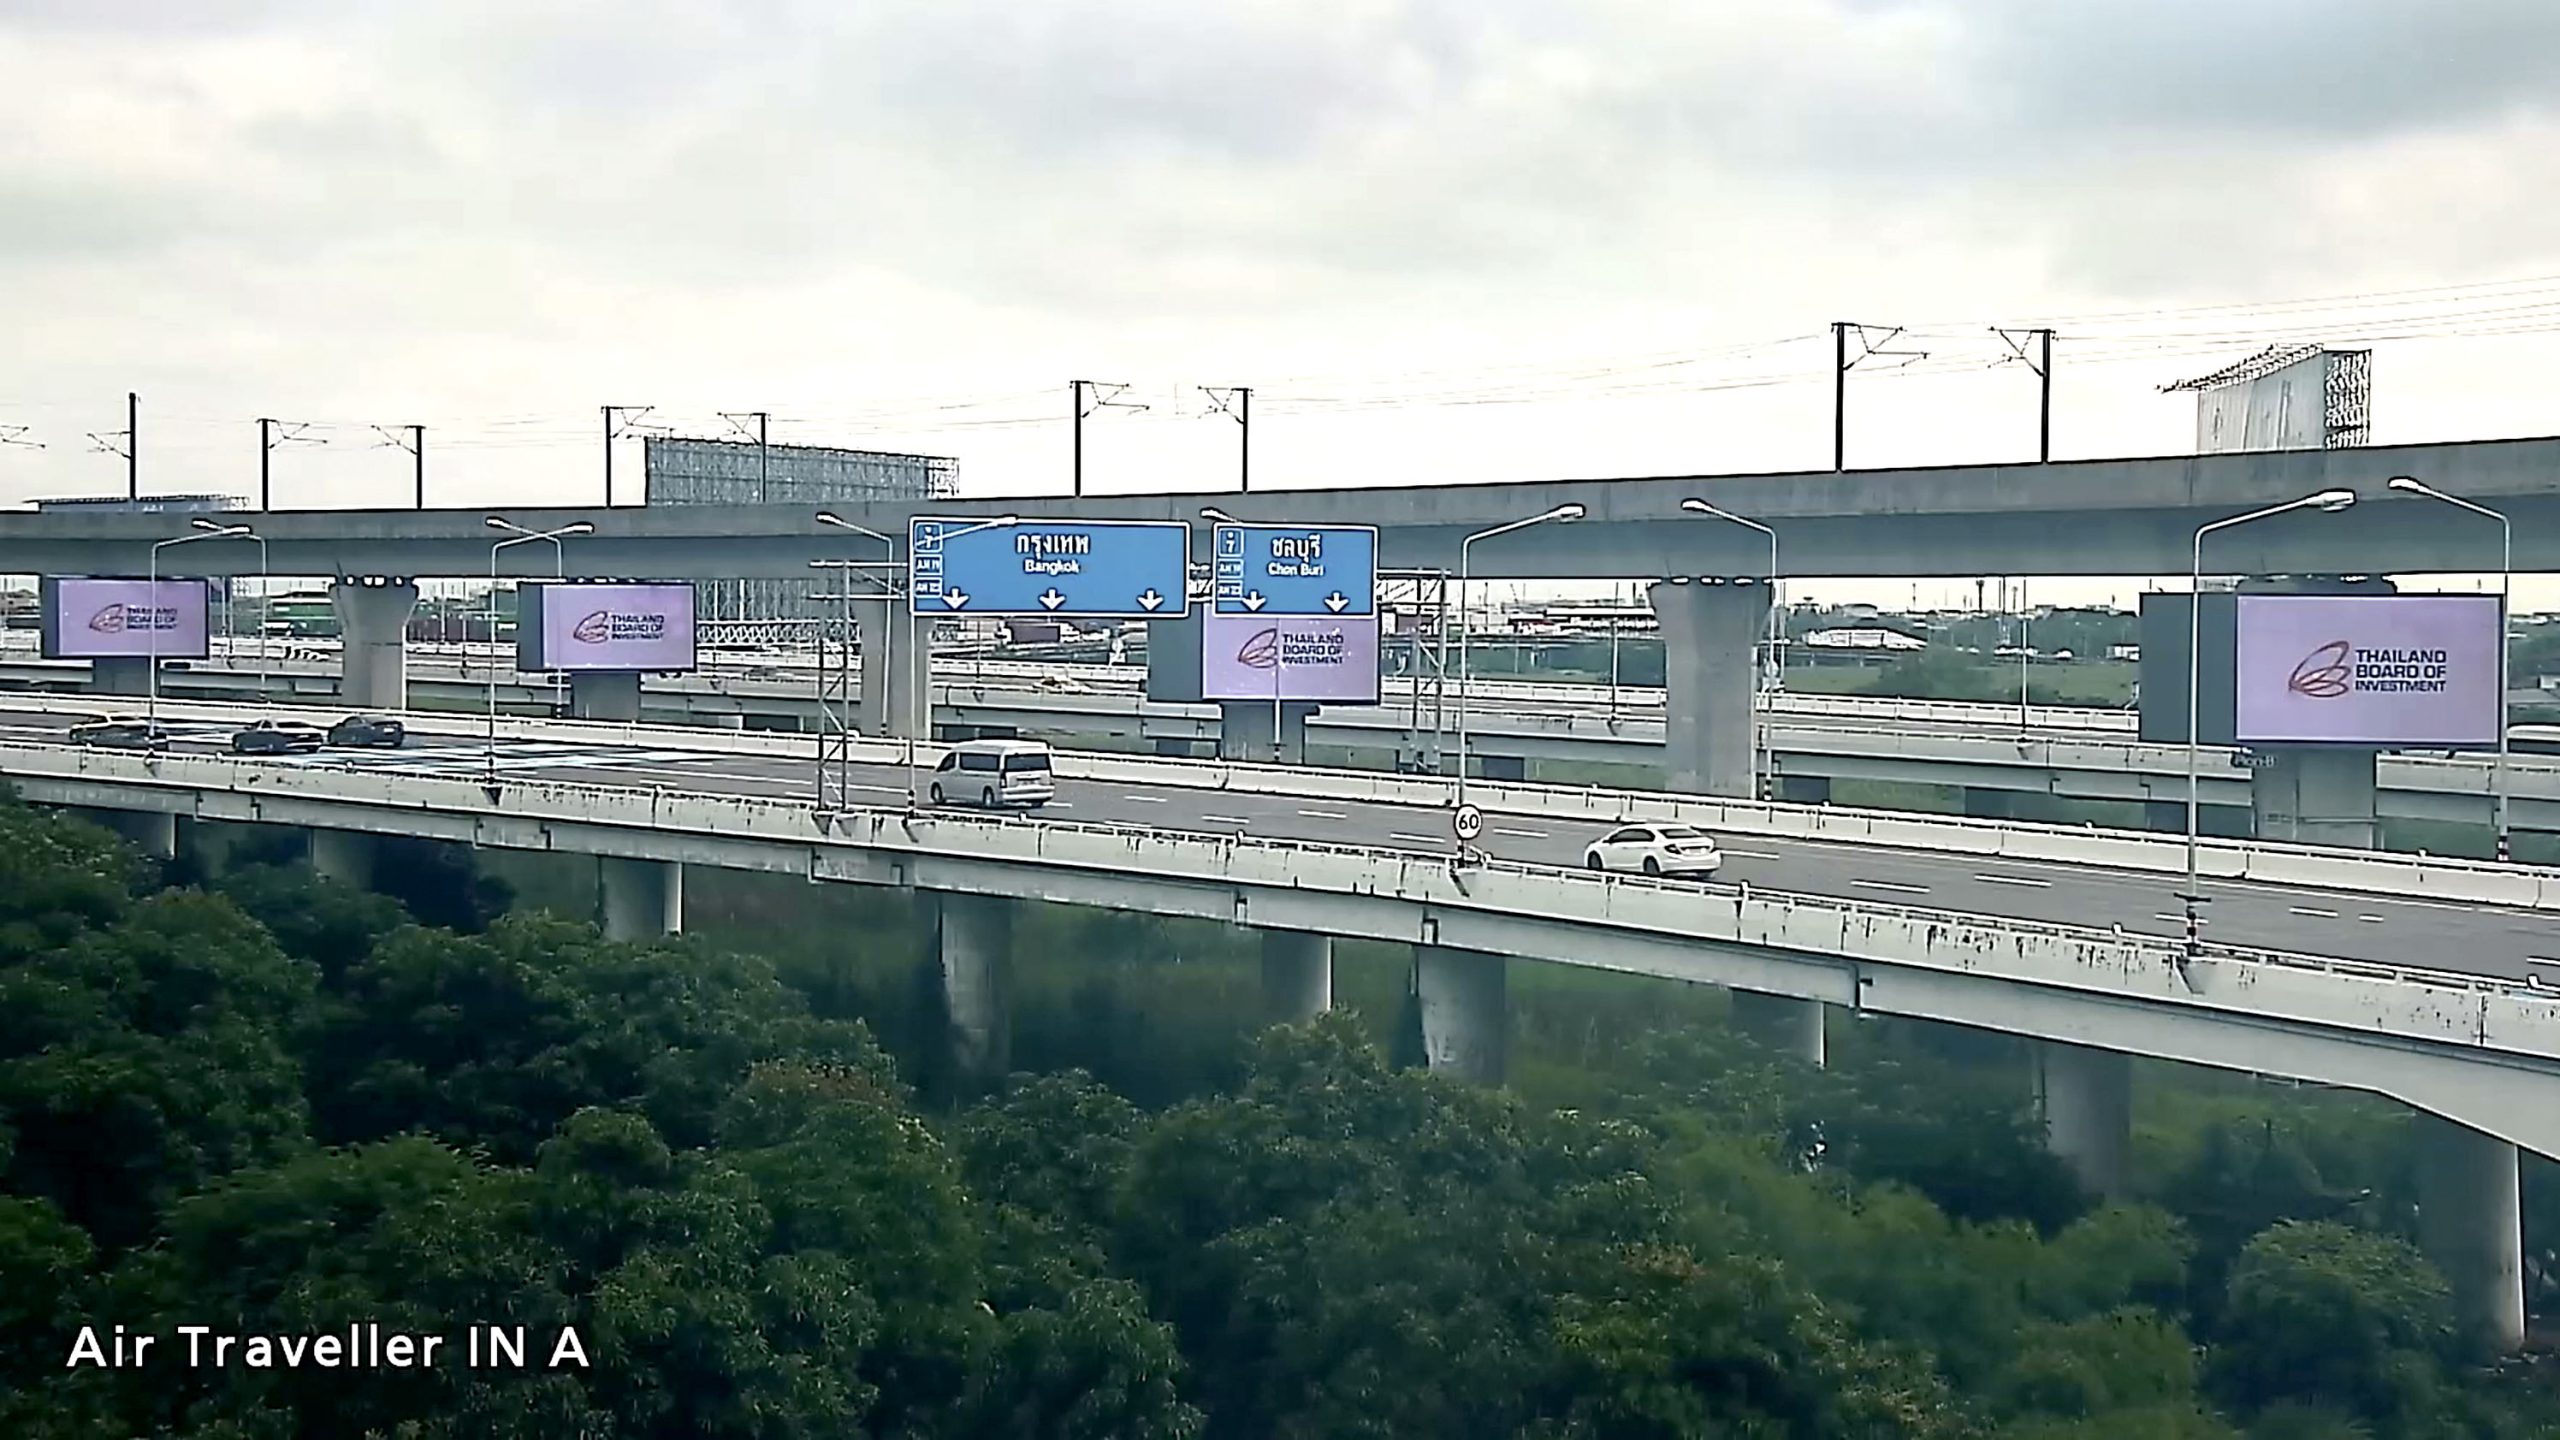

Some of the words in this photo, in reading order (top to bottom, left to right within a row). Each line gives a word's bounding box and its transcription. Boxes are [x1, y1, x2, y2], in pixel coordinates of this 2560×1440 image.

[1016, 534, 1090, 559] กรุงเทพ
[1225, 540, 1235, 553] 7
[1271, 534, 1322, 562] ชลบุรี
[1024, 559, 1080, 575] Bangkok
[1267, 562, 1298, 576] Chon
[1300, 563, 1324, 576] Buri
[1282, 634, 1344, 644] THAILAND
[1283, 645, 1325, 655] BOARD
[1328, 645, 1343, 655] OF
[2355, 649, 2447, 663] THAILAND
[2356, 665, 2419, 679] BOARD
[2424, 665, 2447, 679] OF
[2355, 680, 2447, 692] INVESTMENT
[1458, 813, 1479, 830] 60
